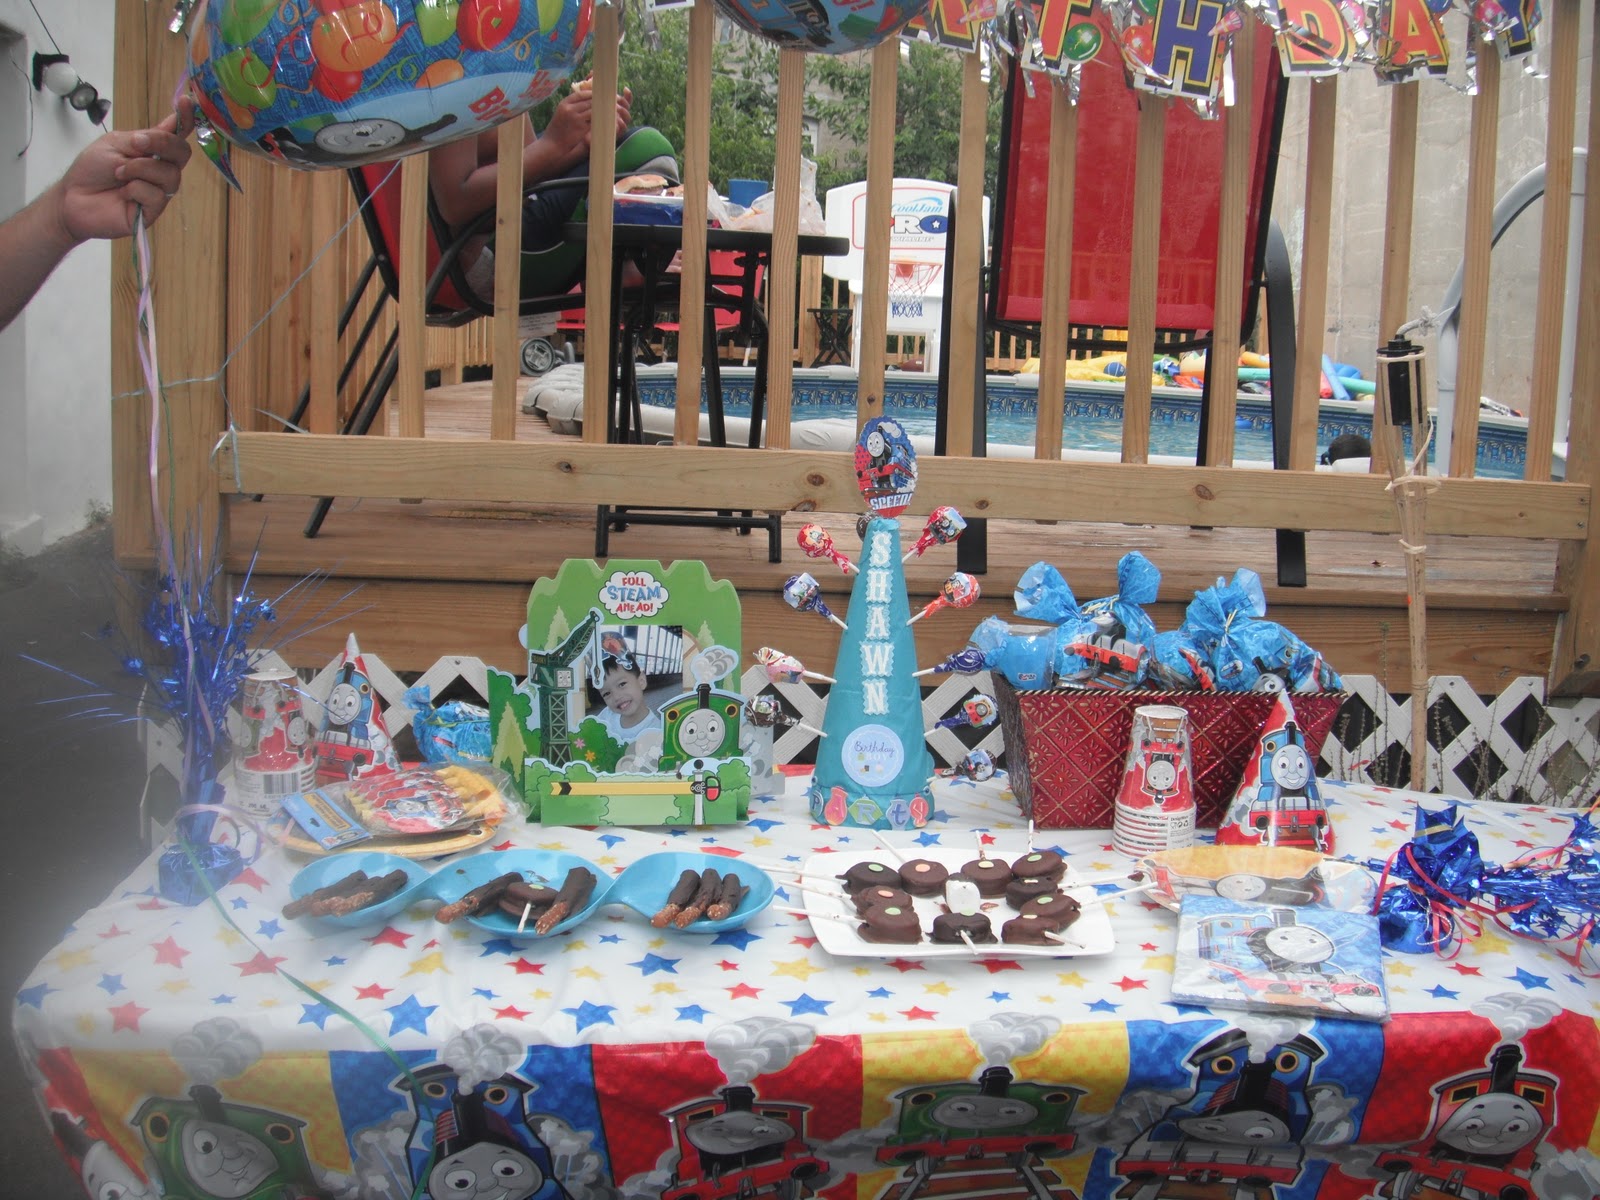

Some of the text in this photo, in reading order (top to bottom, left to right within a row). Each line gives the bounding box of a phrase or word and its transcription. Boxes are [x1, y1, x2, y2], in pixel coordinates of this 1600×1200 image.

[890, 214, 948, 235] RO
[621, 577, 647, 587] FULL
[607, 585, 662, 602] STEAM
[616, 602, 654, 613] AHEAD!
[862, 532, 894, 715] SHAWN
[854, 741, 896, 759] Birthday
